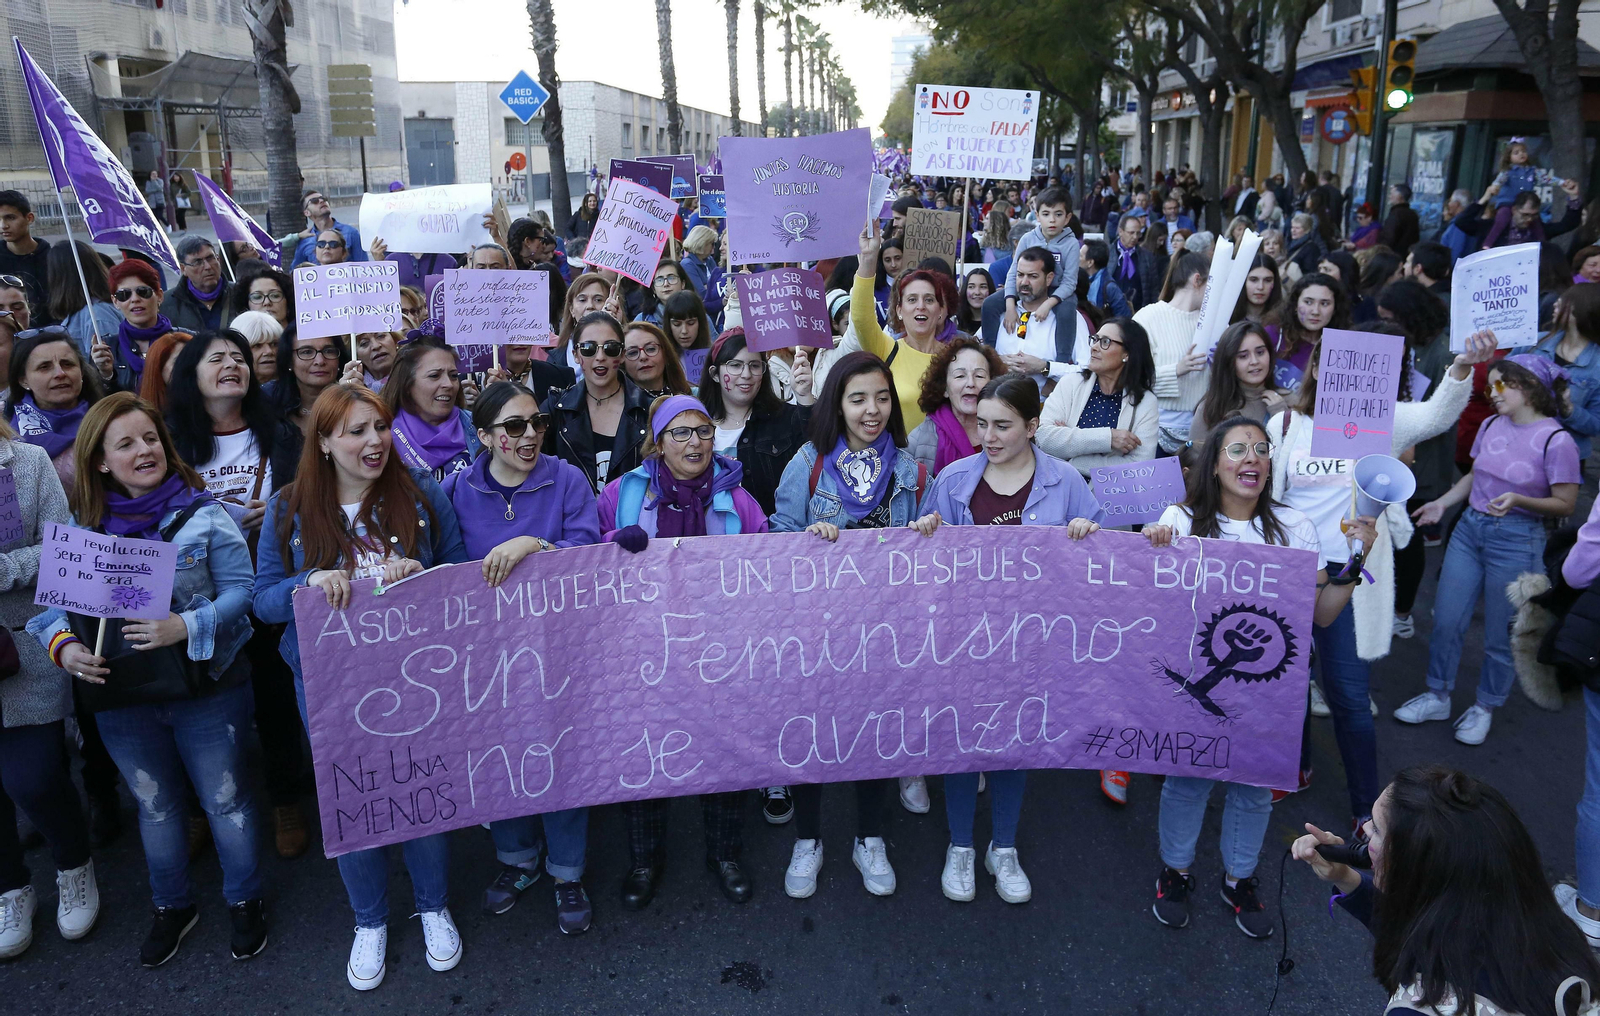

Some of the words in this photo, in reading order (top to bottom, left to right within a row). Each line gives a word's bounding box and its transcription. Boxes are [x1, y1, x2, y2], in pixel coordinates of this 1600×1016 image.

[507, 97, 540, 105] BASICA
[514, 88, 532, 96] RED
[931, 90, 970, 110] NO
[980, 91, 1020, 111] Son
[990, 121, 1030, 137] FALDA
[916, 139, 939, 159] SON
[946, 136, 1018, 153] MUJERES
[752, 157, 790, 186] JUNTAS
[797, 154, 844, 179] HACEMOS
[925, 152, 1024, 174] ASESINADAS
[772, 182, 820, 196] HISTORIA
[599, 203, 617, 222] al
[912, 210, 943, 226] SOMOS
[417, 213, 461, 234] GUAPA
[594, 227, 608, 243] es
[623, 235, 643, 256] la
[584, 244, 650, 285] ignorancia
[731, 250, 738, 261] 8
[298, 269, 318, 285] LO
[326, 264, 397, 279] CONTRARIO
[450, 271, 468, 291] Los
[479, 277, 538, 292] violadores
[744, 276, 764, 290] VOY
[771, 274, 780, 286] A
[782, 272, 803, 284] SER
[1489, 275, 1511, 288] NOS
[301, 288, 322, 302] AL
[748, 292, 762, 303] LA
[766, 285, 803, 300] MUJER
[805, 286, 820, 300] QUE
[1472, 284, 1528, 302] QUITARON
[454, 305, 490, 317] antes
[500, 306, 527, 318] que
[749, 305, 767, 317] ME
[770, 302, 788, 315] DE
[791, 300, 803, 311] LA
[1482, 297, 1519, 312] TANTO
[300, 311, 312, 325] ES
[316, 309, 331, 320] LA
[755, 317, 790, 336] GANA
[794, 314, 808, 328] DE
[810, 316, 826, 333] SER
[456, 319, 473, 334] las
[1327, 349, 1380, 374] DESTRUYE
[1381, 354, 1391, 376] EL
[1323, 371, 1389, 395] PATRIARCADO
[1320, 397, 1336, 415] NO
[1337, 398, 1346, 417] EL
[1348, 398, 1389, 419] PLANETA
[1121, 466, 1156, 479] ESTOY
[1296, 459, 1346, 476] LOVE
[227, 476, 250, 487] YORK
[1103, 486, 1127, 495] CON
[52, 525, 69, 543] La
[92, 555, 153, 573] feminista
[78, 570, 93, 581] no
[444, 590, 480, 630] DE
[496, 567, 660, 621] MUJERES
[718, 557, 773, 597] UN
[791, 554, 867, 593] DIA
[888, 546, 1042, 586] DESPUES
[1087, 553, 1128, 586] EL
[1153, 555, 1283, 598] BORGE
[354, 643, 571, 737] Sin
[640, 604, 1157, 685] Feminismo
[467, 726, 573, 809] no
[619, 727, 704, 789] se
[778, 690, 1069, 768] avanza
[1082, 727, 1230, 769] #8MARZO
[336, 782, 457, 841] MENOS
